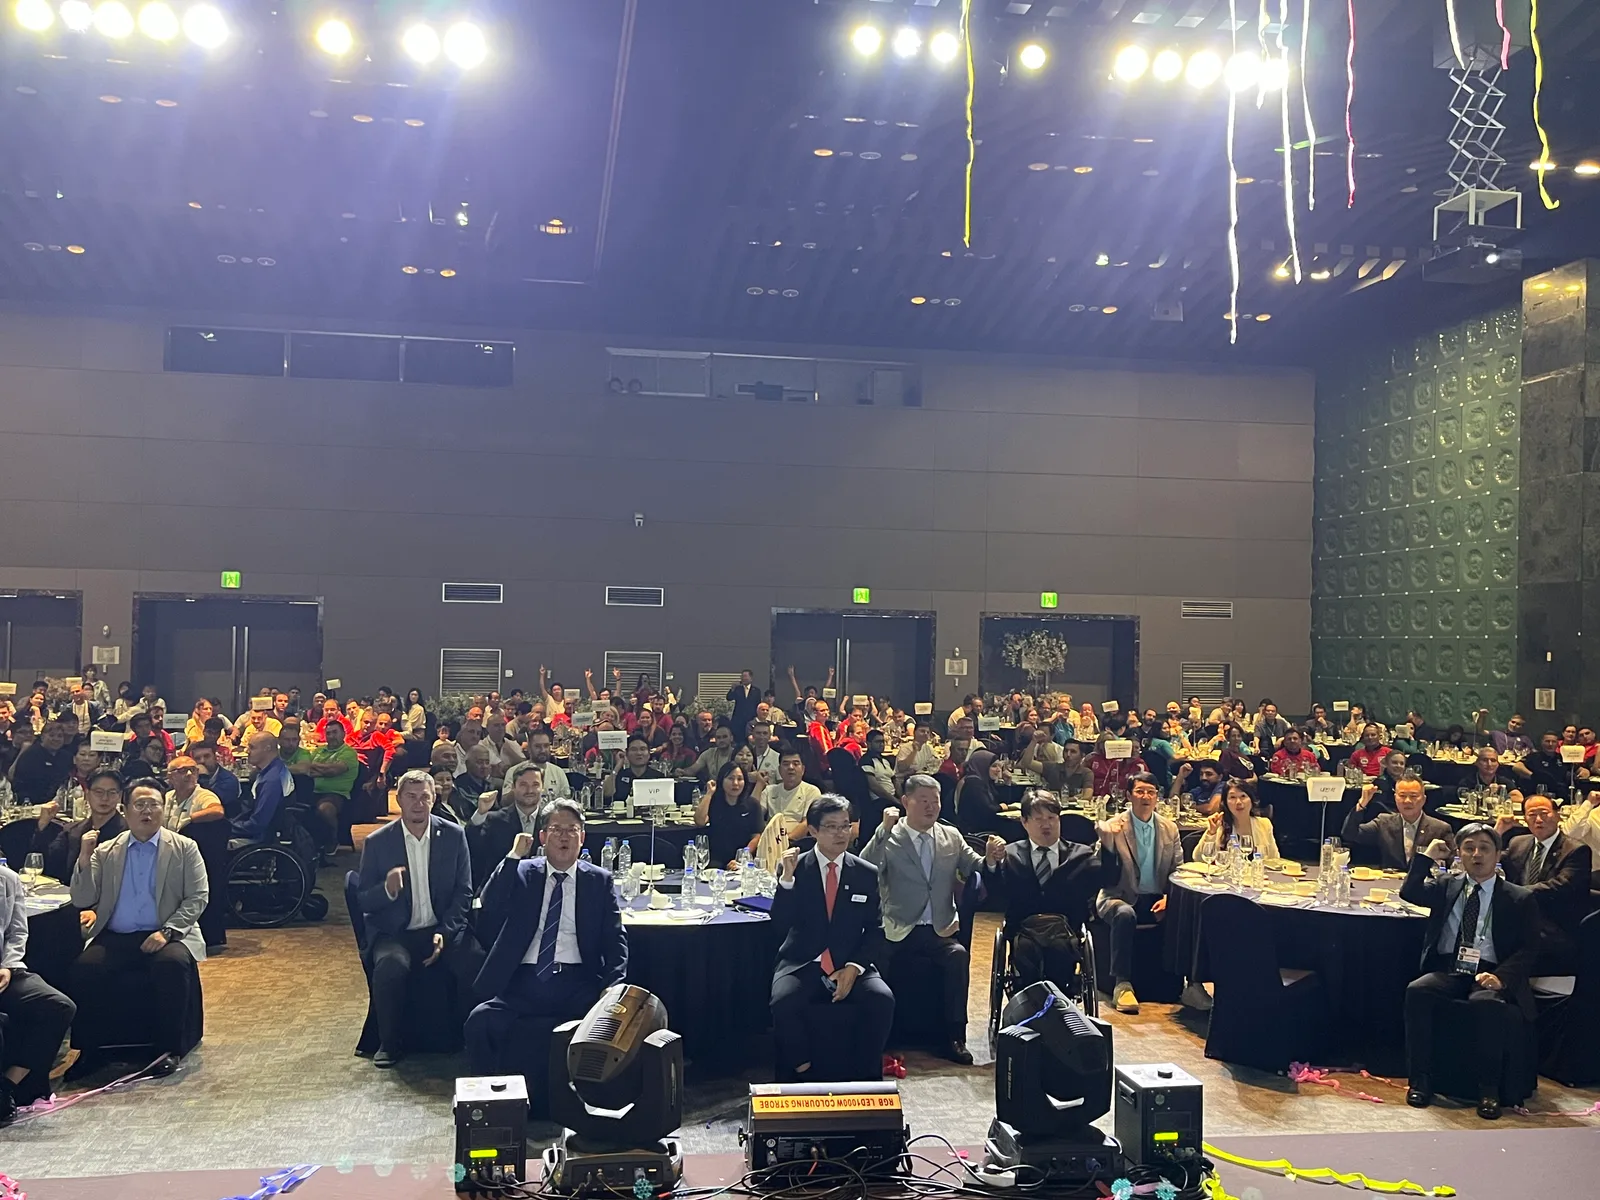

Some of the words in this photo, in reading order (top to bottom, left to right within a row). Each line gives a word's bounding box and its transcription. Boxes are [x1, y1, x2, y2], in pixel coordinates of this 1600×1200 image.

[759, 1100, 789, 1109] STROBE
[791, 1099, 835, 1109] COLOURING
[837, 1098, 875, 1108] LED1000W
[878, 1098, 894, 1107] RGB
